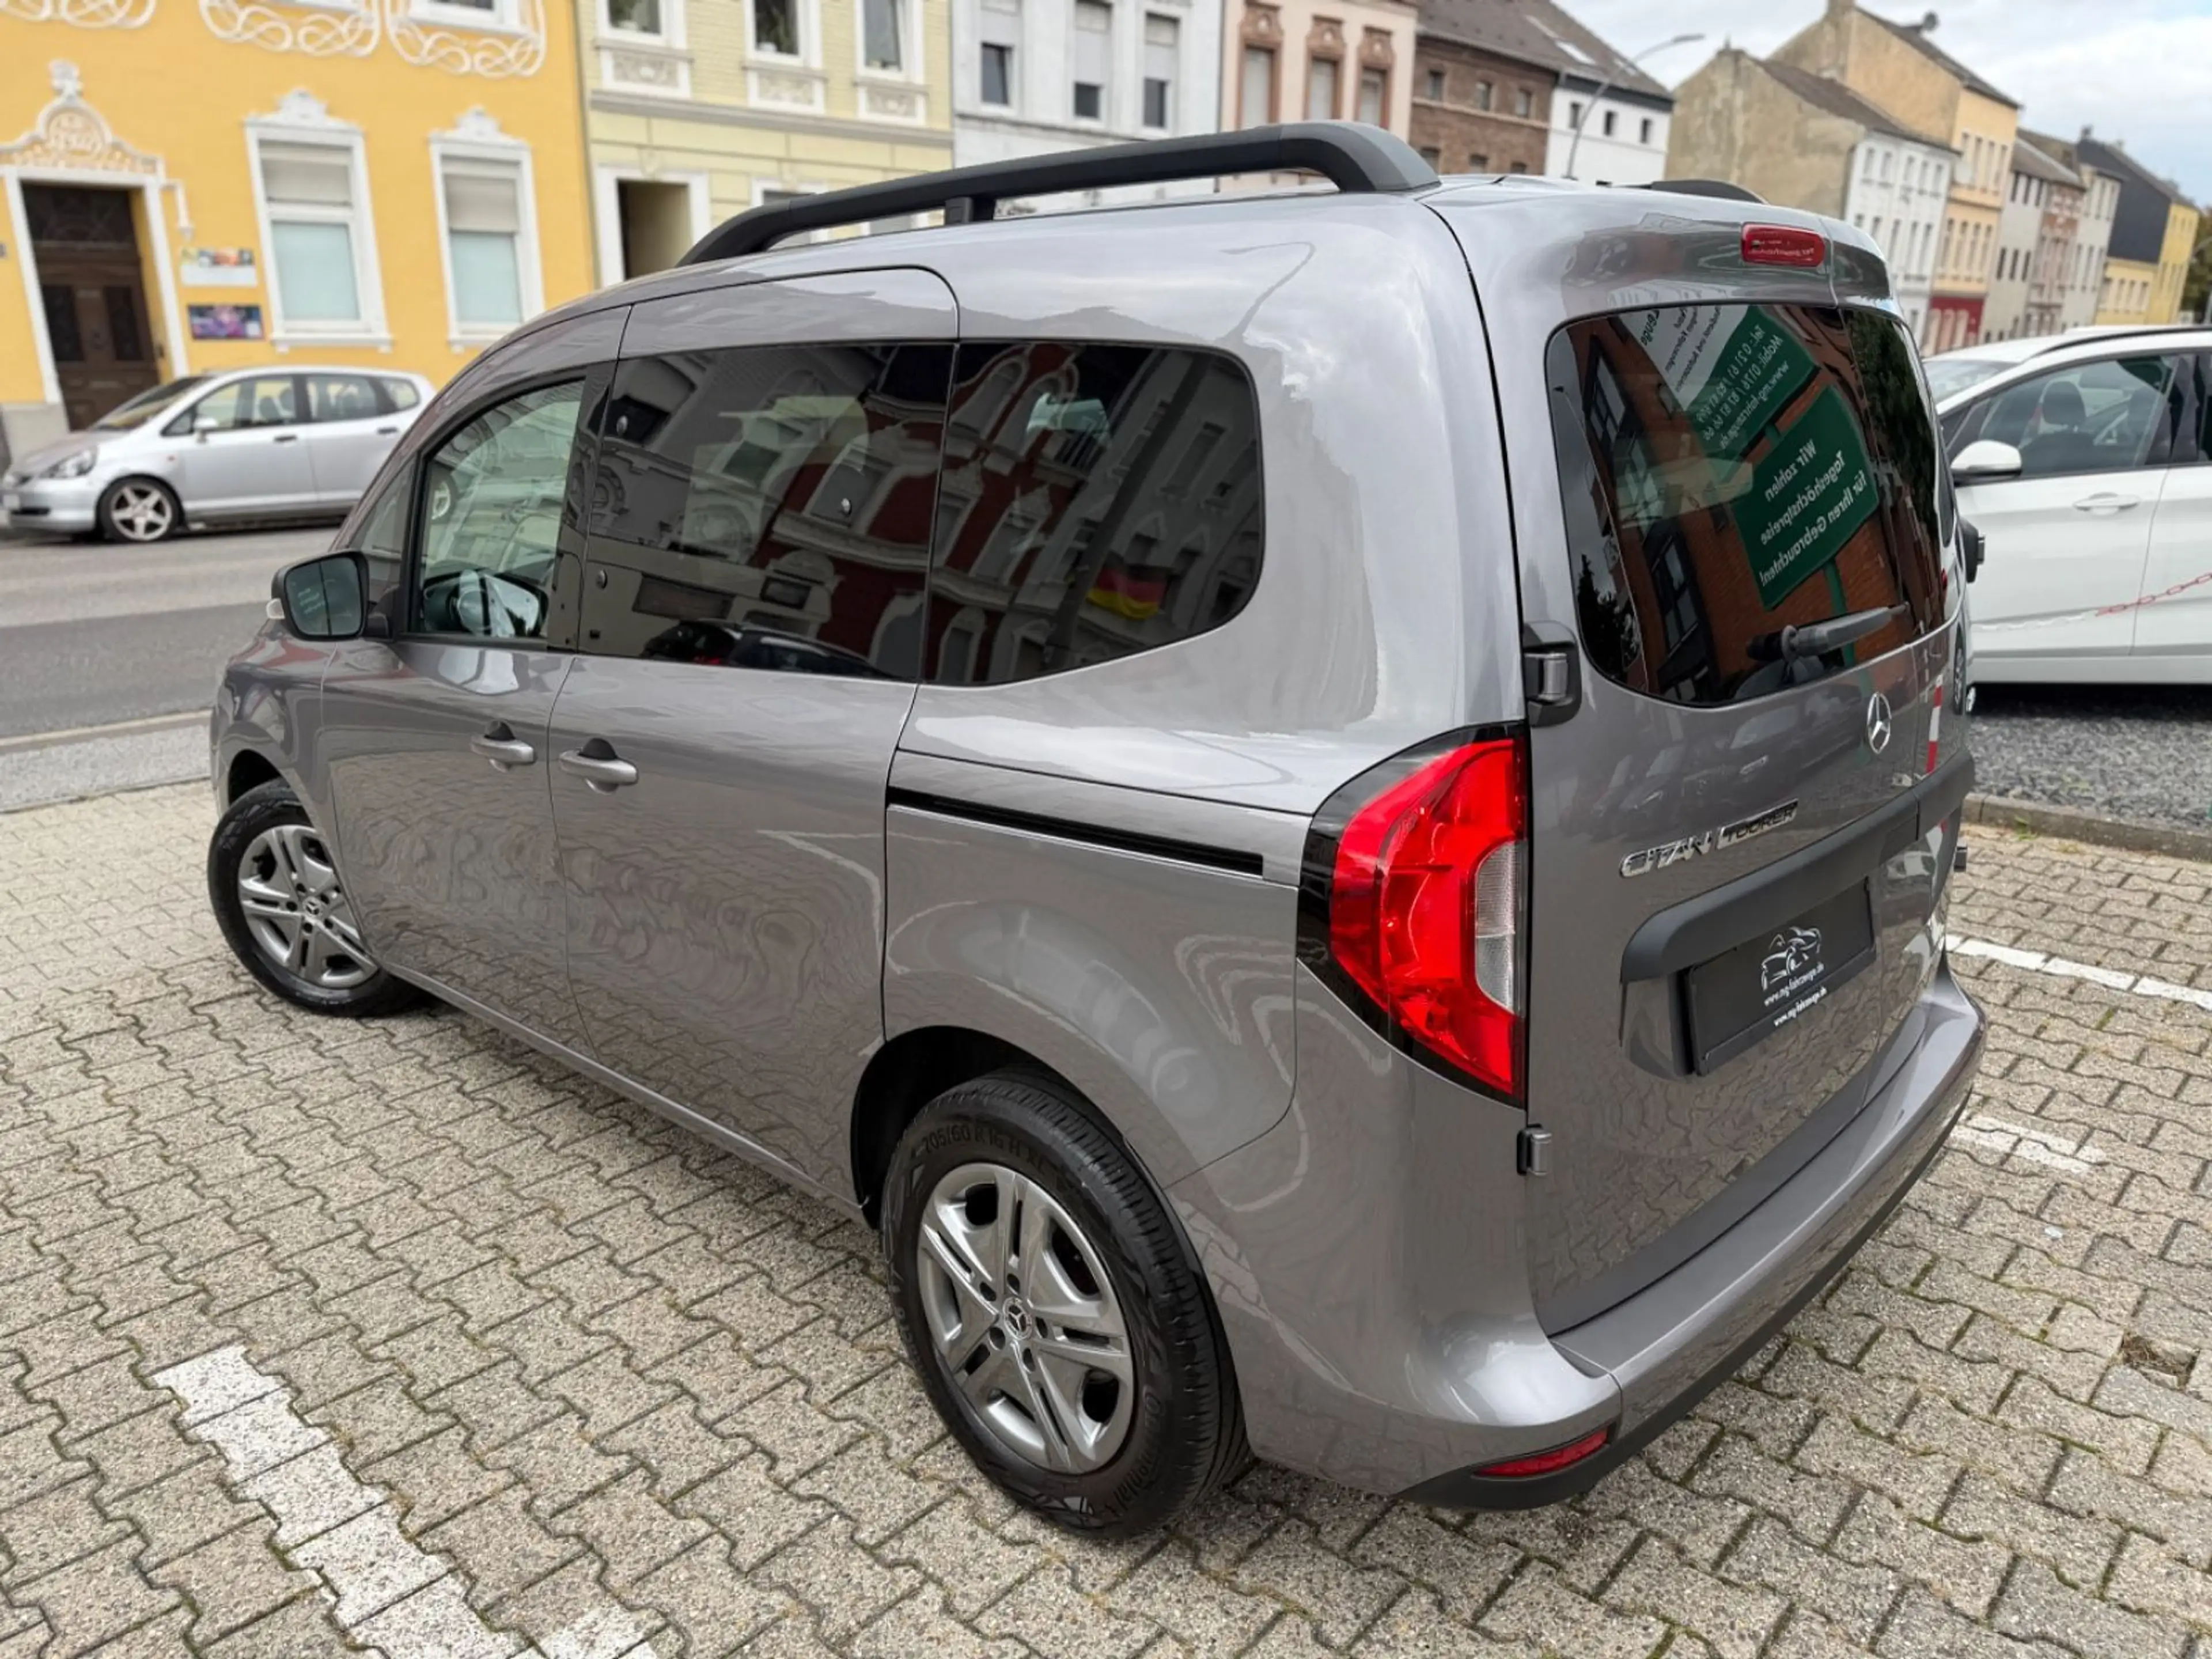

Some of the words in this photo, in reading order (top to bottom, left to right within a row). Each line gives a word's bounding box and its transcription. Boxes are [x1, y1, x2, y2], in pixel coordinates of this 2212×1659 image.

[1620, 830, 1712, 878] CITAN
[1722, 800, 1797, 846] TOURER
[922, 1124, 971, 1153] 205/60
